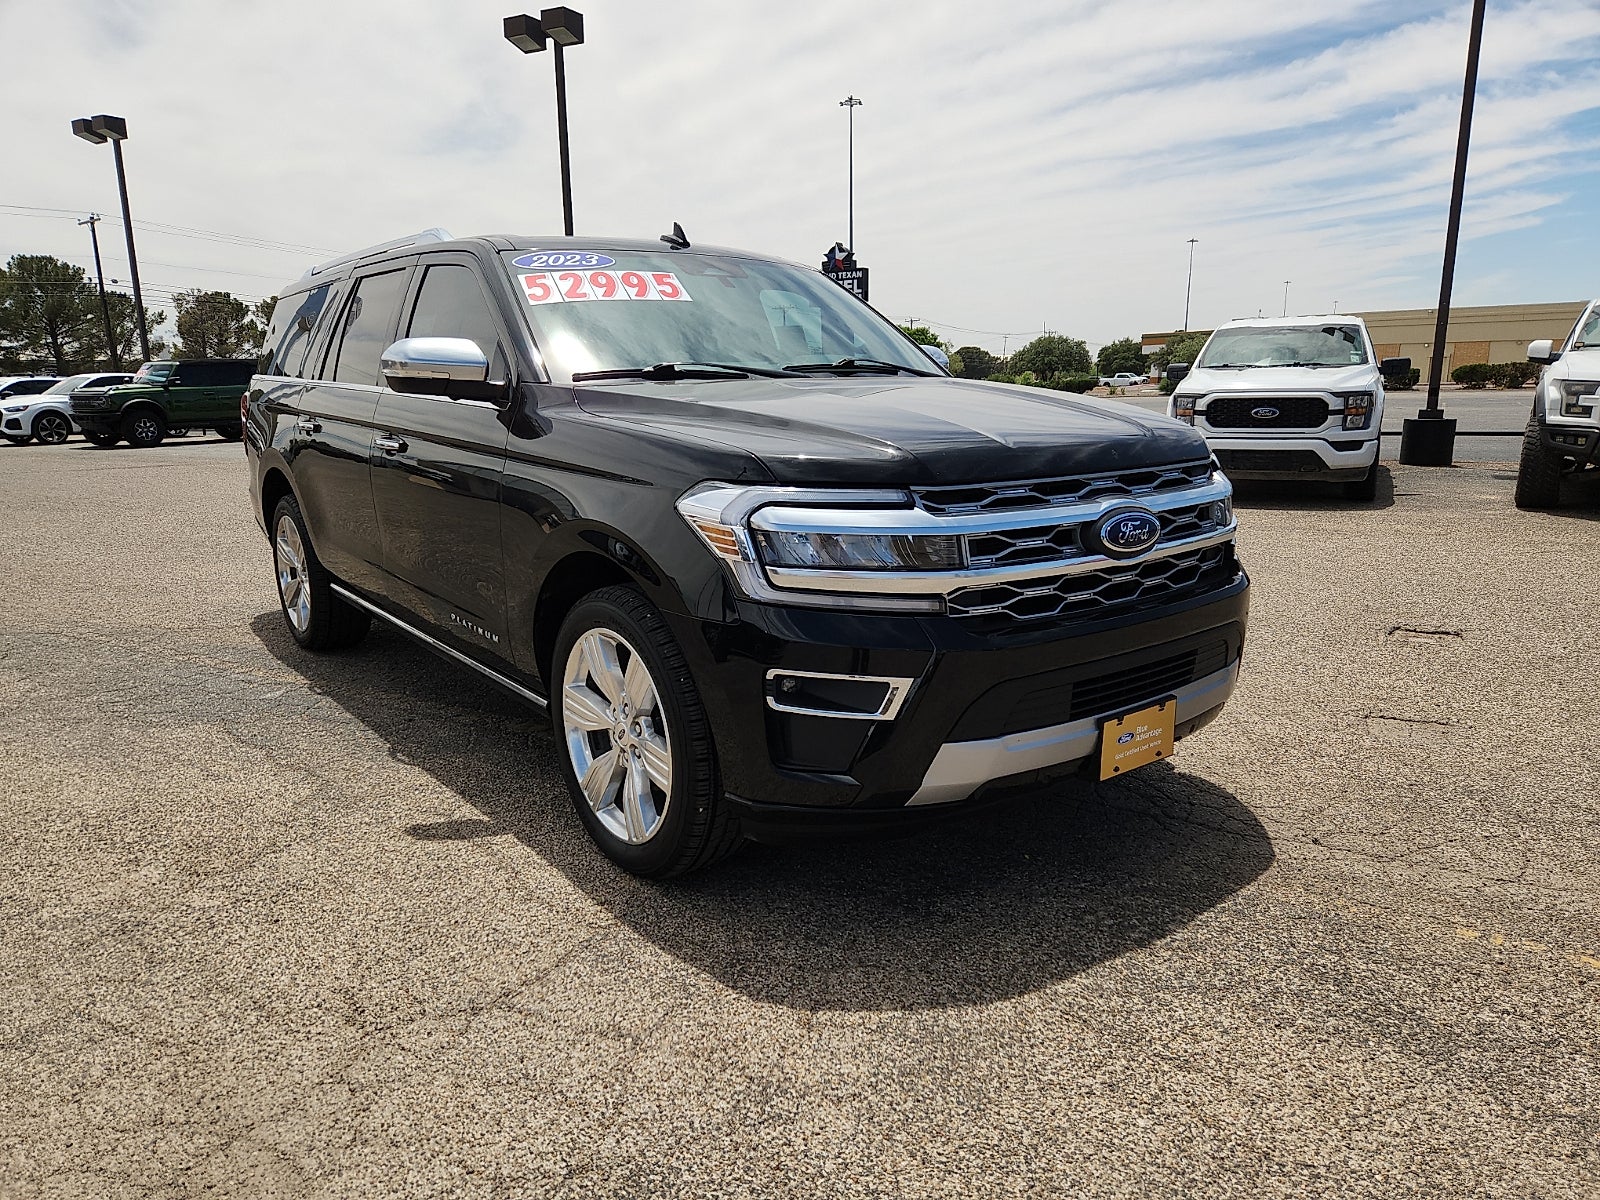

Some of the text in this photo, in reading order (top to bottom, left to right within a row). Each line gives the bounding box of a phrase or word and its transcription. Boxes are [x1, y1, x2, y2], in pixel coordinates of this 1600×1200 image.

[529, 254, 599, 267] 2023
[838, 270, 863, 279] TEXAN
[524, 272, 682, 302] 52995
[1119, 521, 1150, 544] Ford
[451, 613, 499, 643] PLATINUM
[1136, 725, 1148, 734] Blue
[1136, 728, 1163, 742] Advantage
[1118, 733, 1134, 744] Ford
